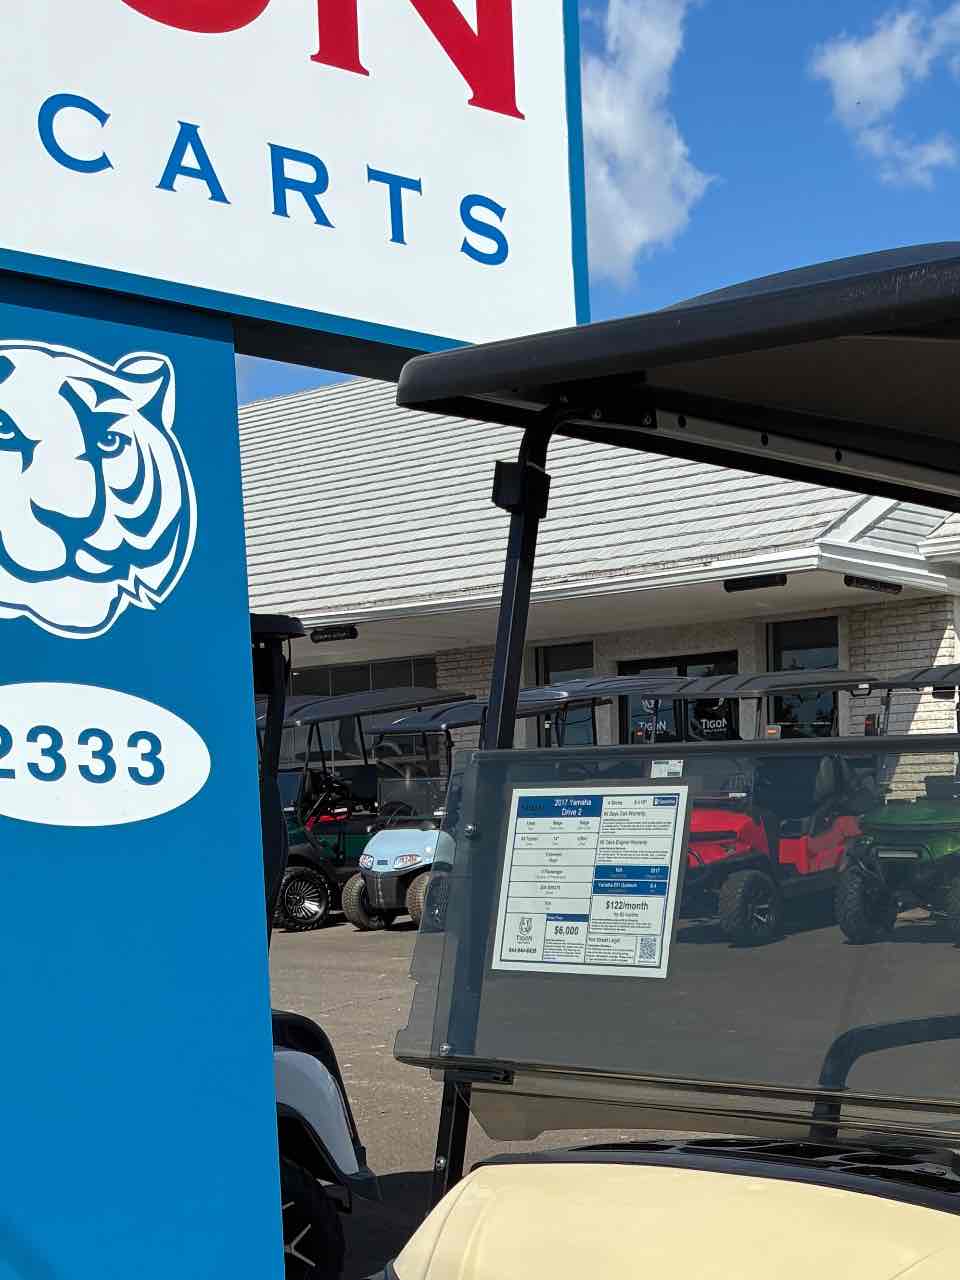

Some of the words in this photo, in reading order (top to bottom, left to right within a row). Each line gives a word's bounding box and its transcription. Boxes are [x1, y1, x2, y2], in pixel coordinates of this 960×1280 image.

[37, 92, 510, 266] CARTS
[553, 799, 568, 807] 2017
[561, 808, 577, 816] Drive
[577, 808, 583, 816] 2
[605, 900, 649, 911] $122/month
[553, 925, 580, 937] $6,000
